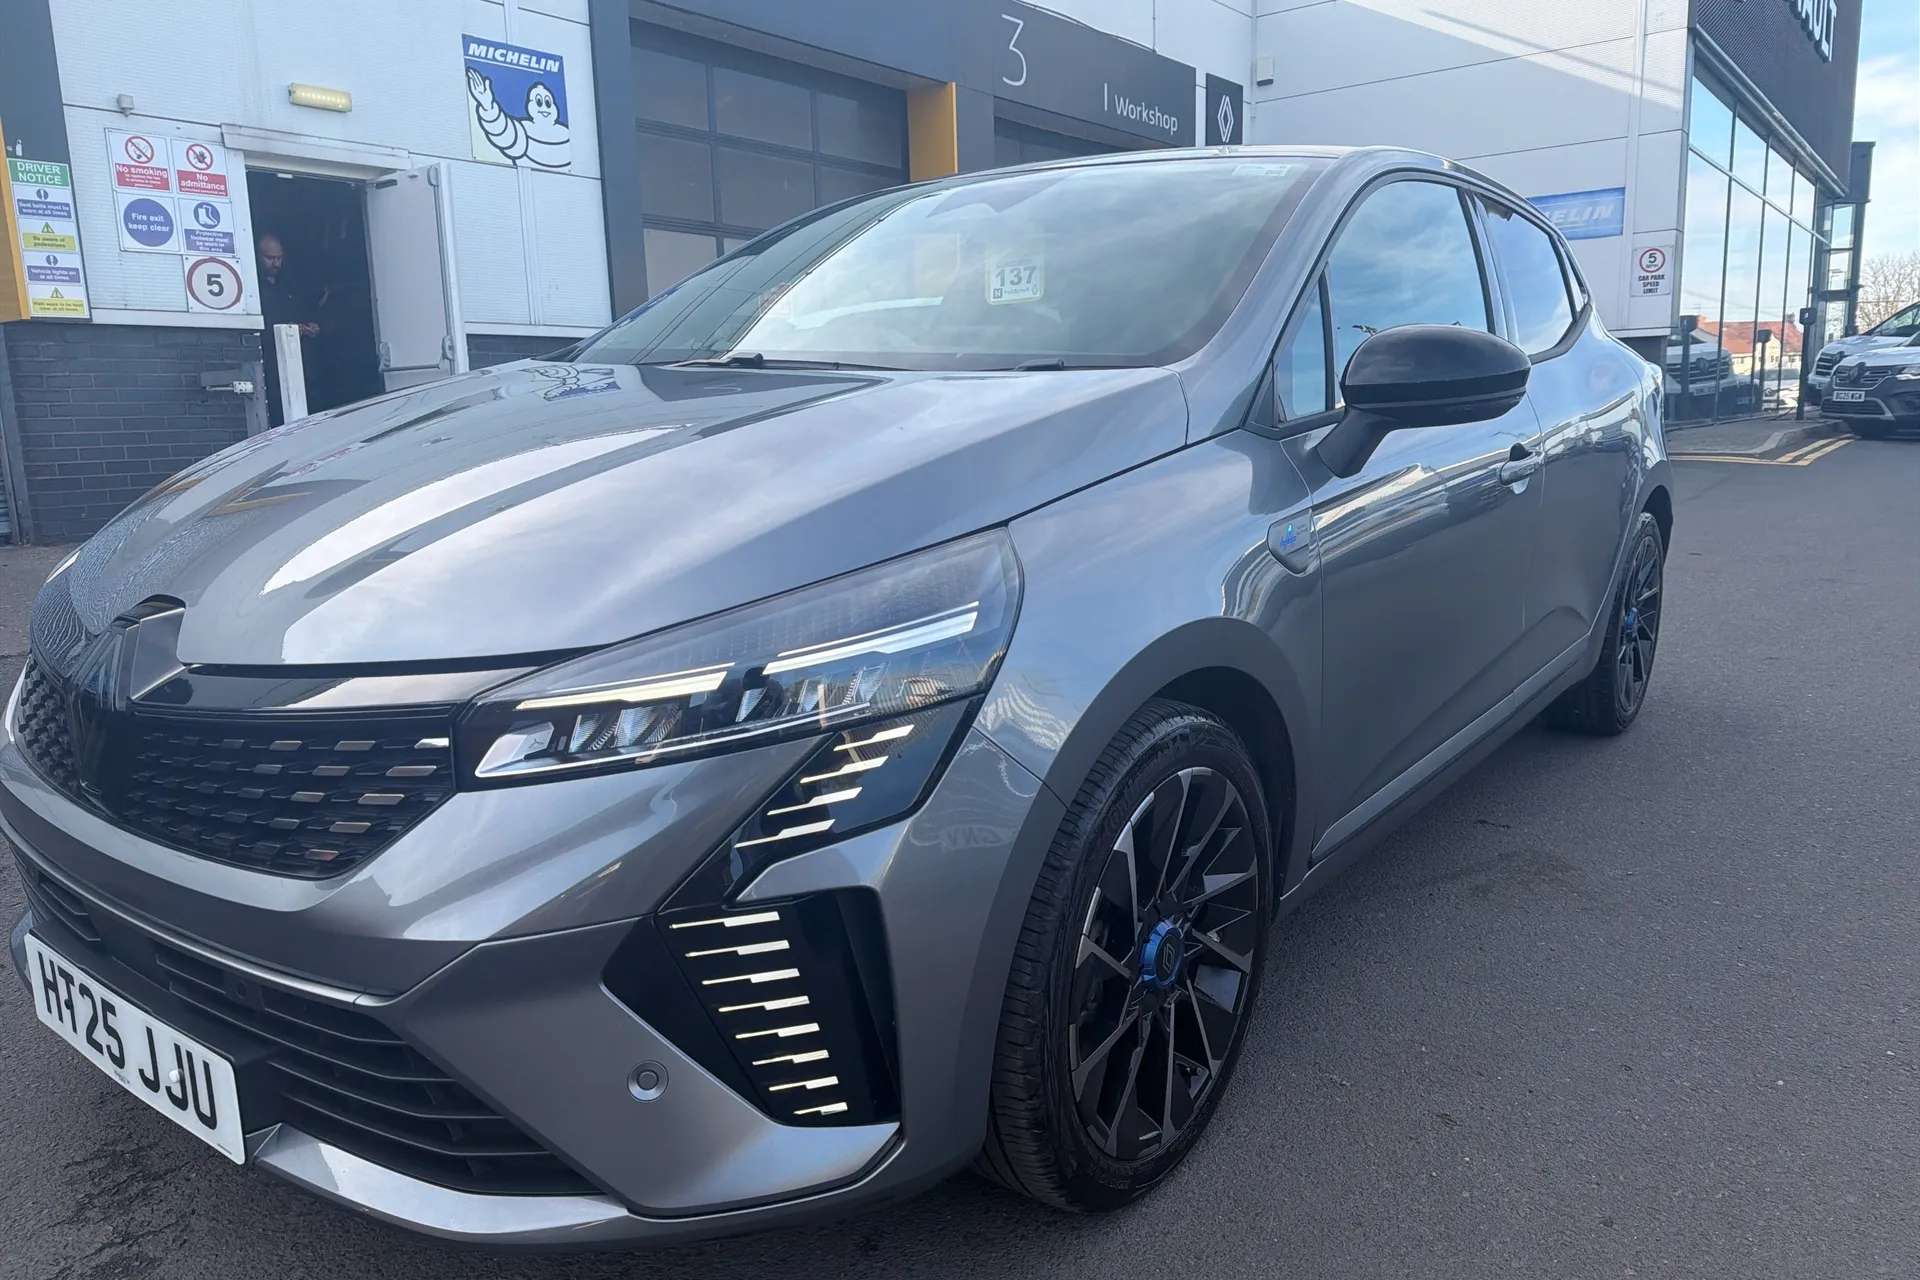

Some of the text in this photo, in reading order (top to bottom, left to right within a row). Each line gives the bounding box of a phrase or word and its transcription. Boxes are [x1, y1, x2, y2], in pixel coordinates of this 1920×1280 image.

[1001, 13, 1027, 86] 3
[468, 42, 560, 73] MICHELIN
[1114, 94, 1178, 135] Workshop
[16, 161, 62, 175] DRIVER
[116, 164, 168, 179] No smoking
[18, 172, 63, 185] NOTICE
[196, 173, 209, 181] No
[180, 179, 225, 190] admittance
[131, 212, 164, 222] Fire exit
[128, 223, 170, 232] keep clear
[1648, 252, 1657, 264] 5
[995, 266, 1037, 287] 137
[206, 273, 225, 297] 5
[37, 950, 218, 1131] HT25 JJU
